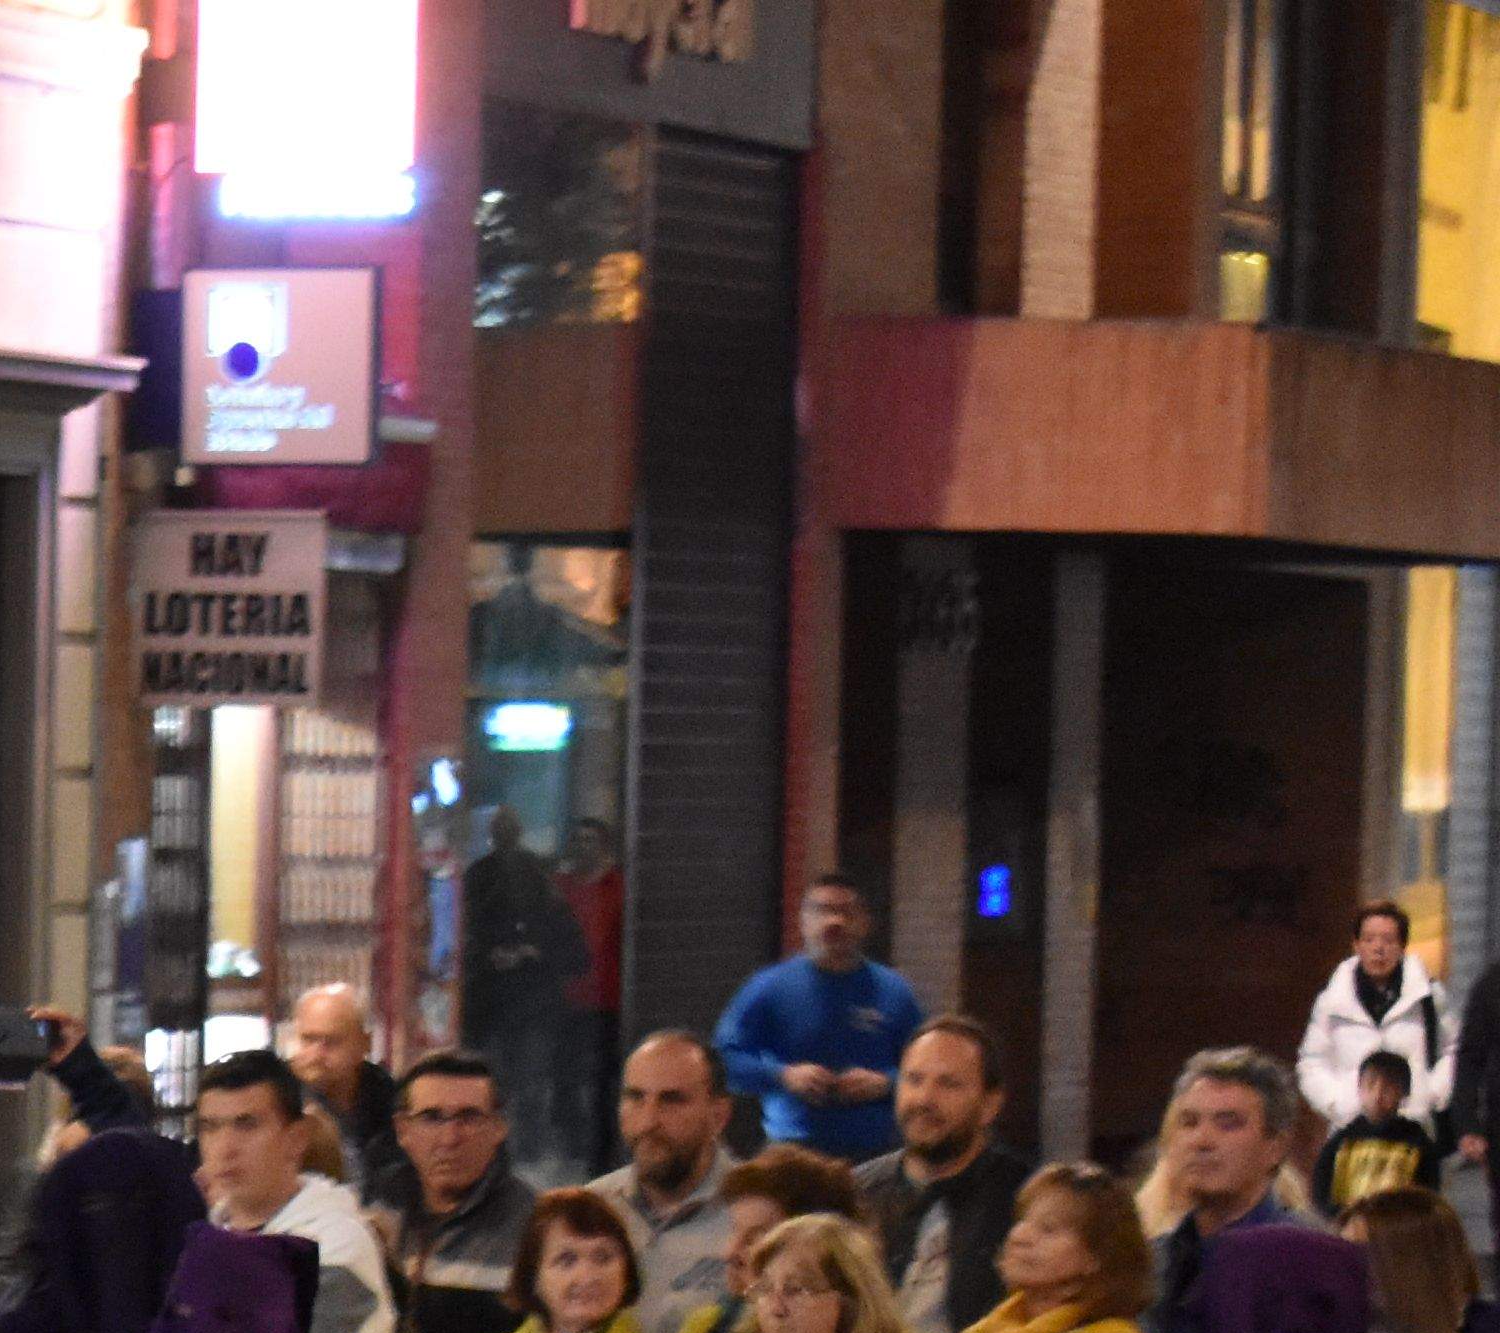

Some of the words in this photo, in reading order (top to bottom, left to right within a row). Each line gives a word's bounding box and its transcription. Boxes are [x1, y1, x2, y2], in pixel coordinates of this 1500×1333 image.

[190, 531, 270, 577] HAY
[143, 590, 312, 637] LOTERIA
[141, 650, 308, 695] NACIONAL
